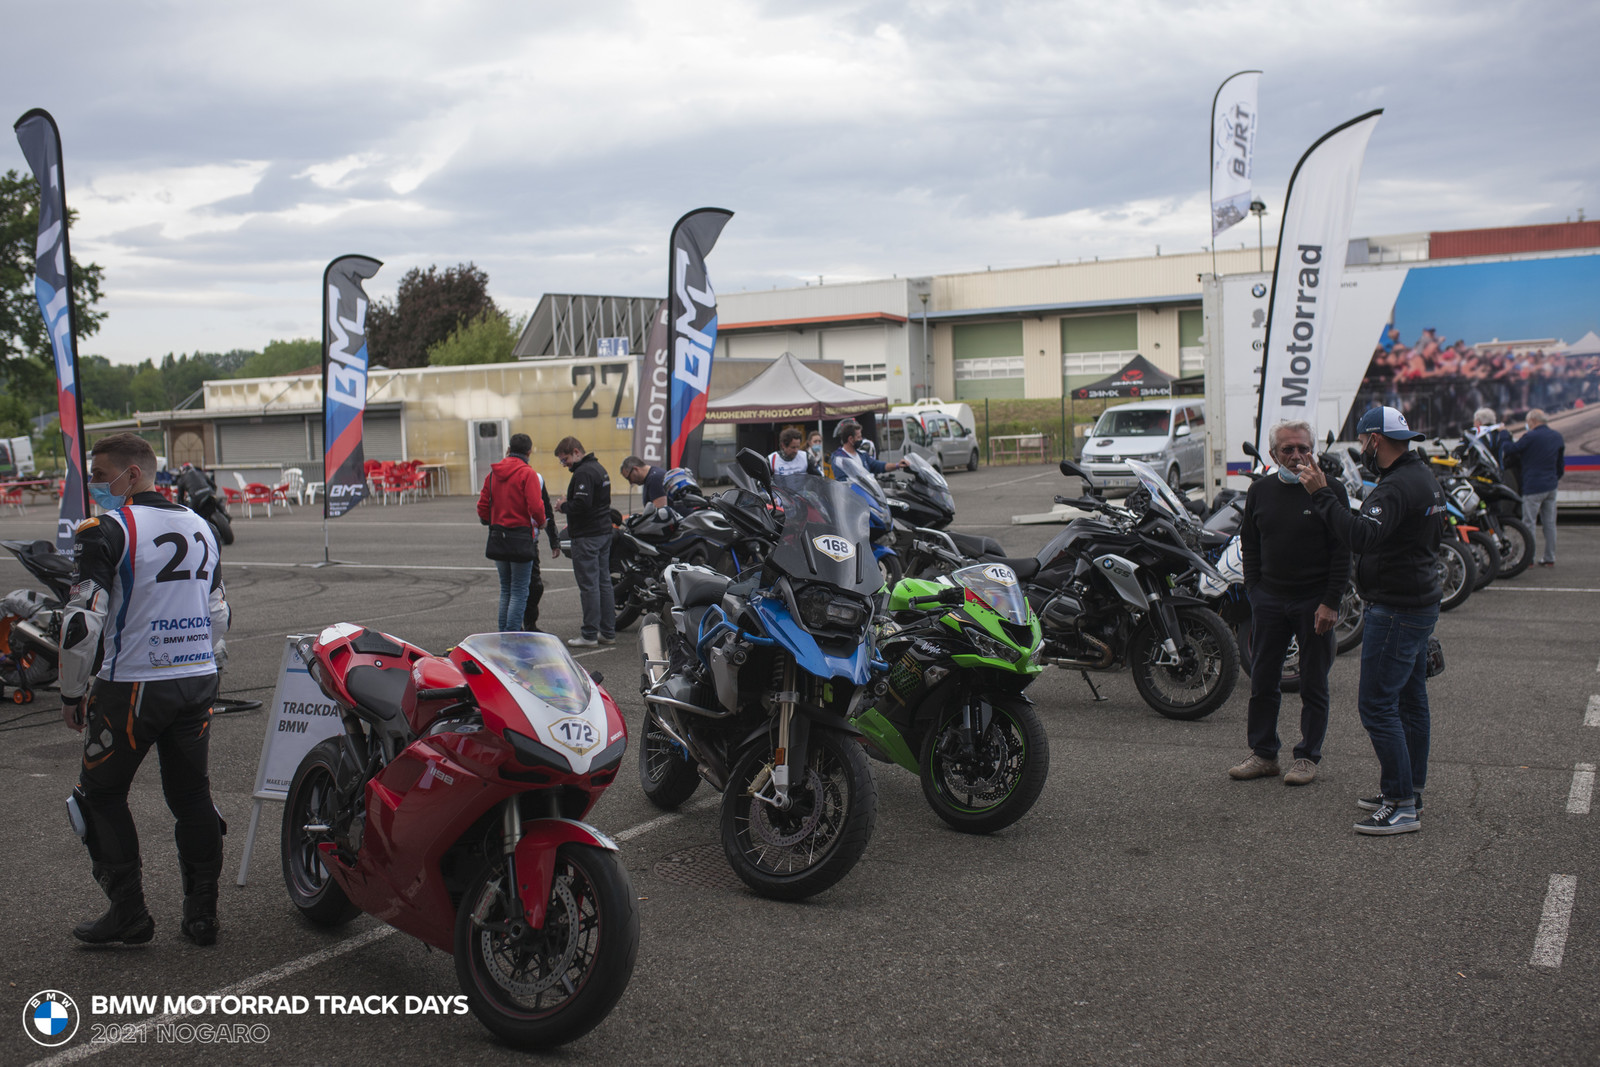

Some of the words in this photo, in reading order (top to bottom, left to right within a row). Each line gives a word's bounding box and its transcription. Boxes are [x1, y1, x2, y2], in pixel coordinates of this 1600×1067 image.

[1233, 103, 1249, 178] BJRT
[1281, 244, 1322, 407] Motorrad
[327, 283, 367, 411] BMC
[571, 363, 629, 419] 27
[644, 348, 668, 462] PHOTOS
[330, 484, 364, 497] BMC
[822, 538, 849, 554] 168
[1113, 566, 1131, 578] GS
[151, 616, 212, 631] TRACKDS
[163, 635, 185, 645] BMW
[278, 720, 309, 734] BMW
[560, 722, 594, 743] 172
